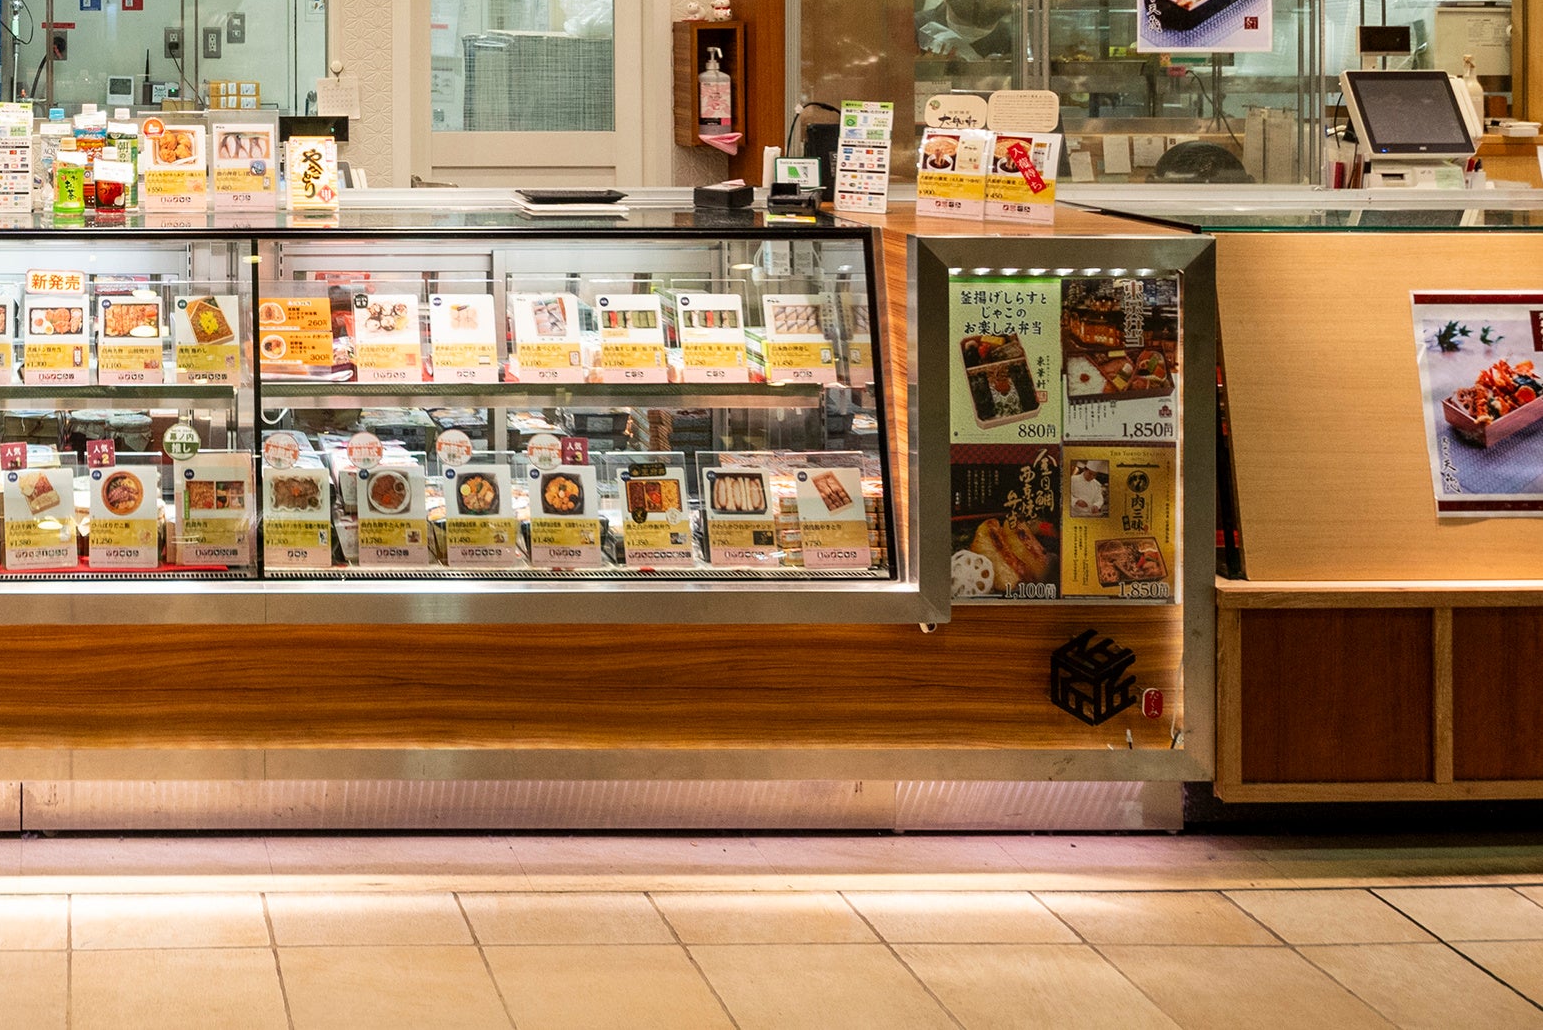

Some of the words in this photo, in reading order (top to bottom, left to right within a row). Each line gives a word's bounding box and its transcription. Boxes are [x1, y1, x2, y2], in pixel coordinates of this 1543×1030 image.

[1012, 146, 1043, 191] 入荷待ち
[31, 273, 81, 292] 新発売
[960, 290, 1048, 306] 釜揚げしらすと
[981, 306, 1027, 320] じゃこの
[964, 320, 1043, 336] お楽しみ弁当
[1036, 355, 1047, 390] 東華軒
[6, 447, 22, 457] 人気
[93, 444, 109, 454] 人気
[171, 443, 191, 453] 推し
[566, 441, 583, 452] 人気
[1033, 448, 1058, 512] 金目鯛
[1019, 464, 1038, 520] 西京焼
[1004, 582, 1057, 599] 1,100円
[1118, 581, 1170, 598] 1,850円
